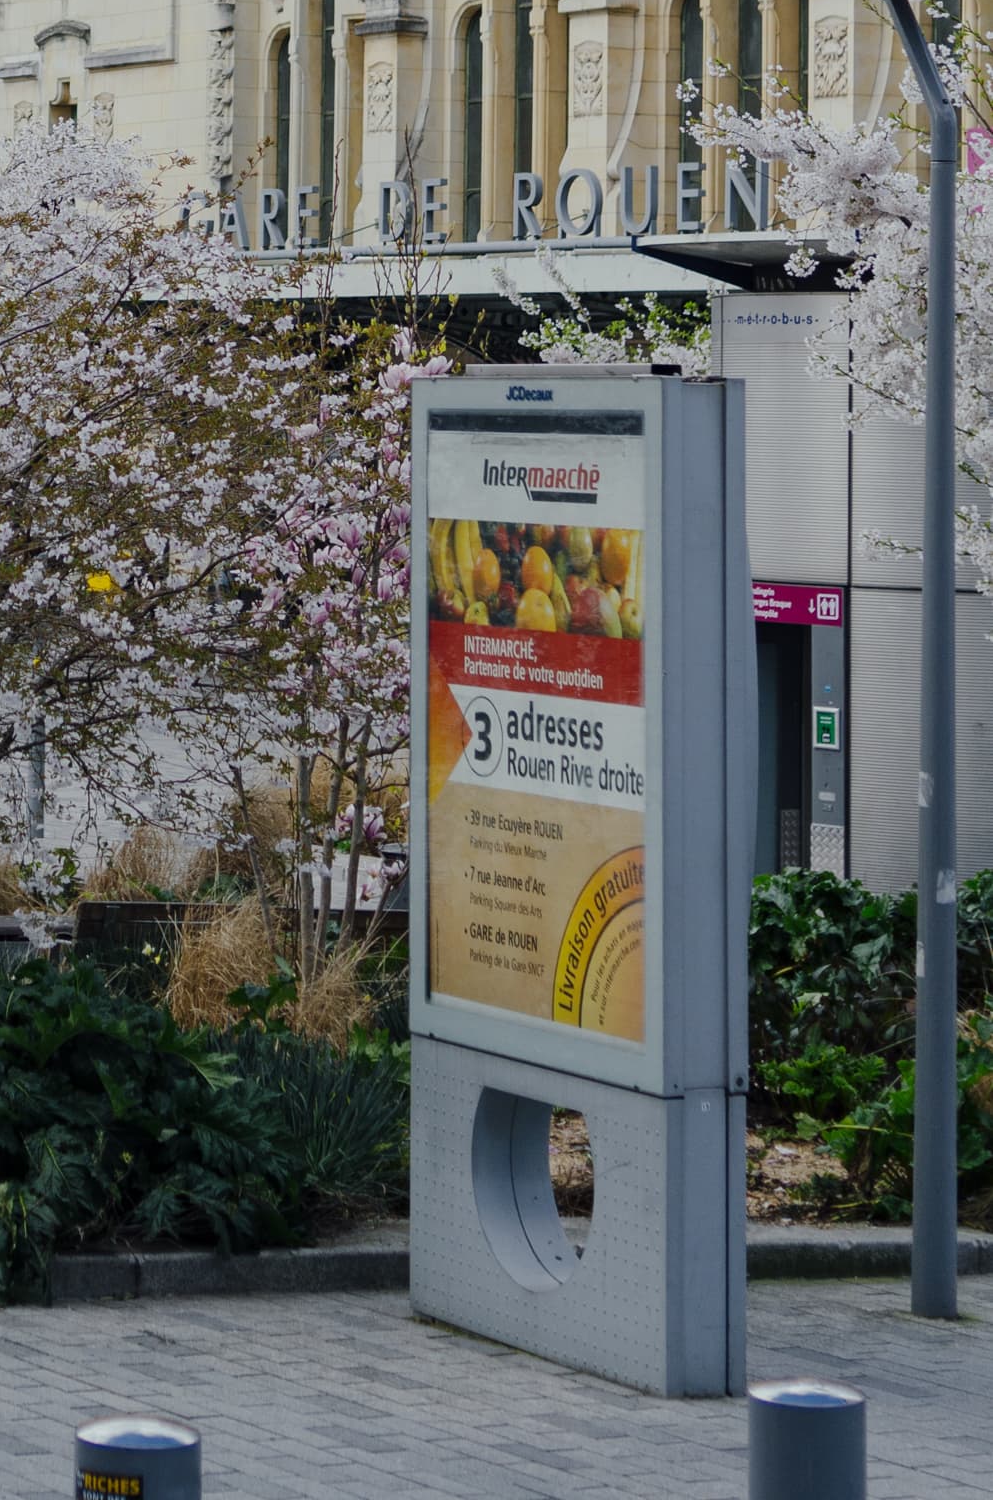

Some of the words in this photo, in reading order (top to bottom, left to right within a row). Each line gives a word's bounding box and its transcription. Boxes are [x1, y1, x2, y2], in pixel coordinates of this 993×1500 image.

[379, 178, 447, 244] DE
[513, 160, 769, 241] ROUEN
[506, 385, 553, 401] JCDecaux
[464, 635, 538, 663] INTERMARCHÉ,
[464, 656, 511, 679] Partenaire
[513, 661, 526, 680] de
[528, 666, 555, 684] votre
[556, 668, 604, 690] quotidien
[474, 711, 493, 762] 3
[507, 700, 604, 751] adresses
[507, 747, 556, 783] Rouen
[560, 754, 594, 788] Rive
[598, 758, 645, 797] droite
[470, 808, 480, 826] 39
[482, 813, 496, 829] rue
[534, 819, 564, 841] ROUEN
[470, 865, 476, 881] 7
[477, 870, 491, 885] rue
[493, 870, 523, 891] Jeanne
[525, 875, 546, 897] d'Arc
[469, 892, 493, 911] Parking
[469, 922, 493, 943] GARE
[495, 927, 506, 945] de
[508, 930, 538, 953] ROUEN
[558, 908, 596, 1012] Livraison
[594, 860, 645, 918] gratuite
[469, 948, 493, 969] Parking
[494, 953, 503, 967] de
[511, 958, 526, 973] Gare
[84, 1472, 140, 1496] RICHES
